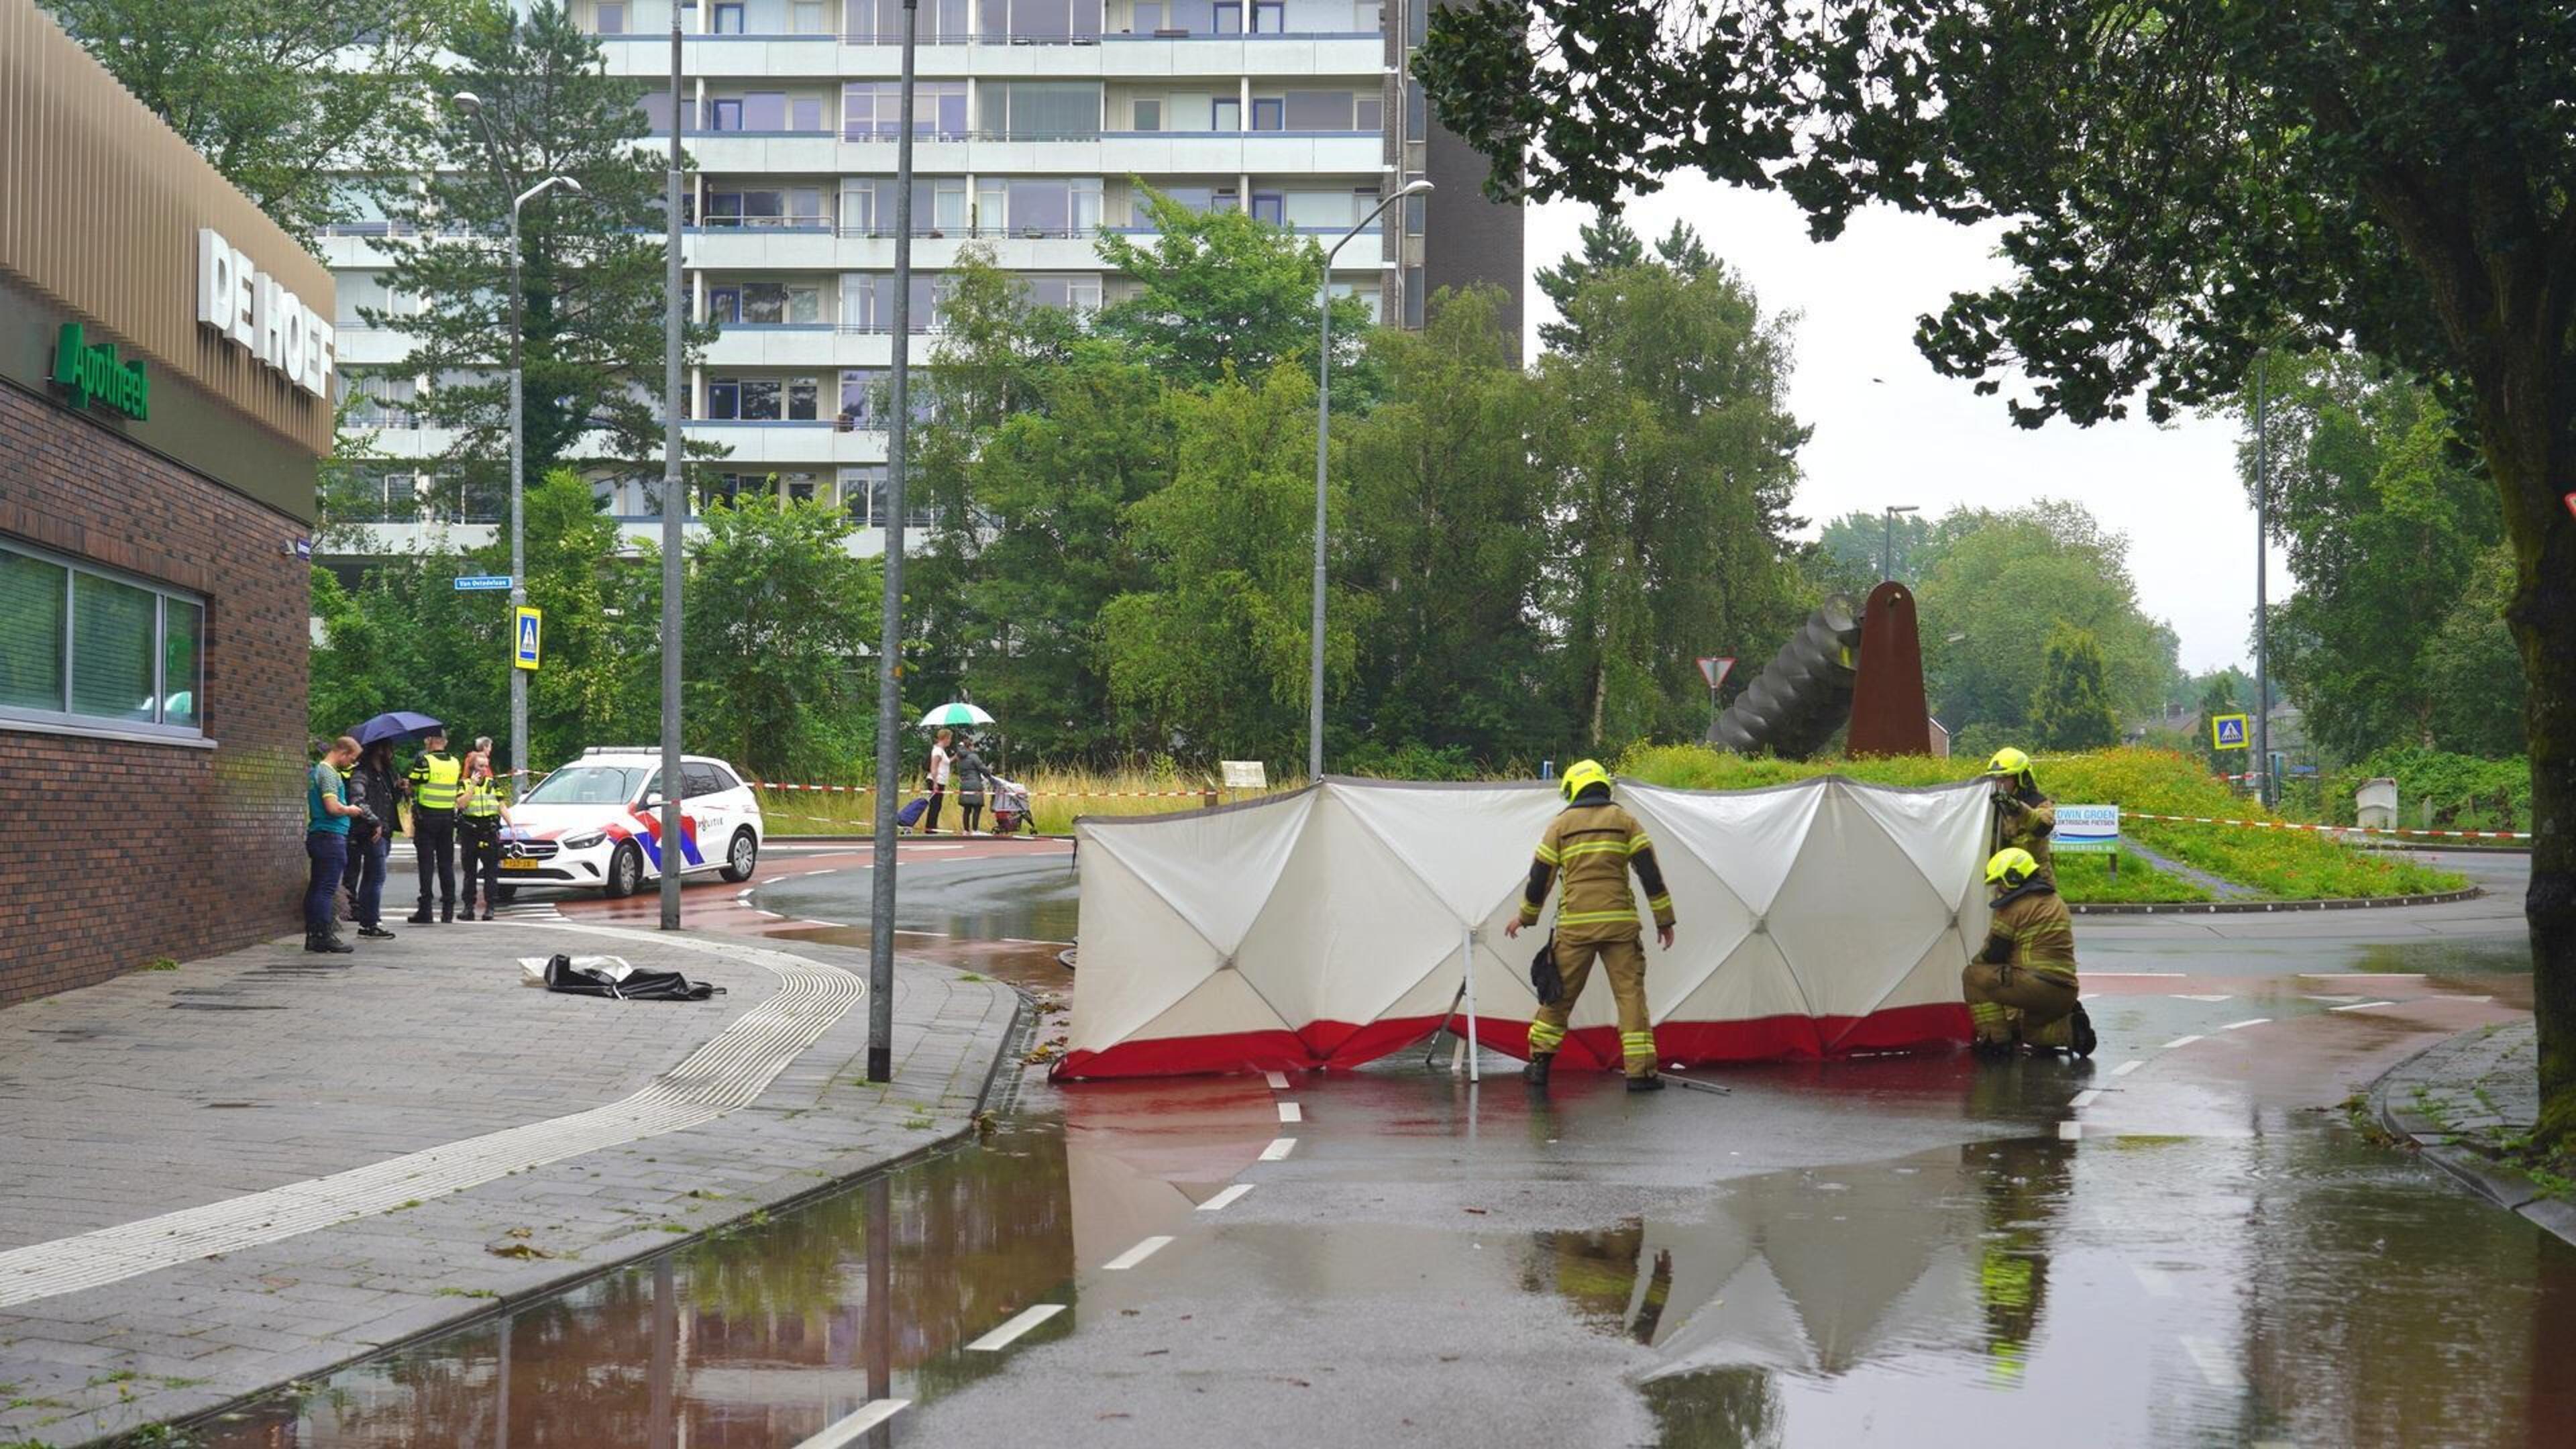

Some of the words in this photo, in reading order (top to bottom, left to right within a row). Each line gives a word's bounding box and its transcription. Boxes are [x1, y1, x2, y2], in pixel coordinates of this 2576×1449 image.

[198, 228, 254, 351] DE
[252, 271, 333, 398] HOEF
[54, 321, 150, 421] Apotheek
[2057, 809, 2082, 818] DWIN
[2084, 809, 2115, 818] GROEN
